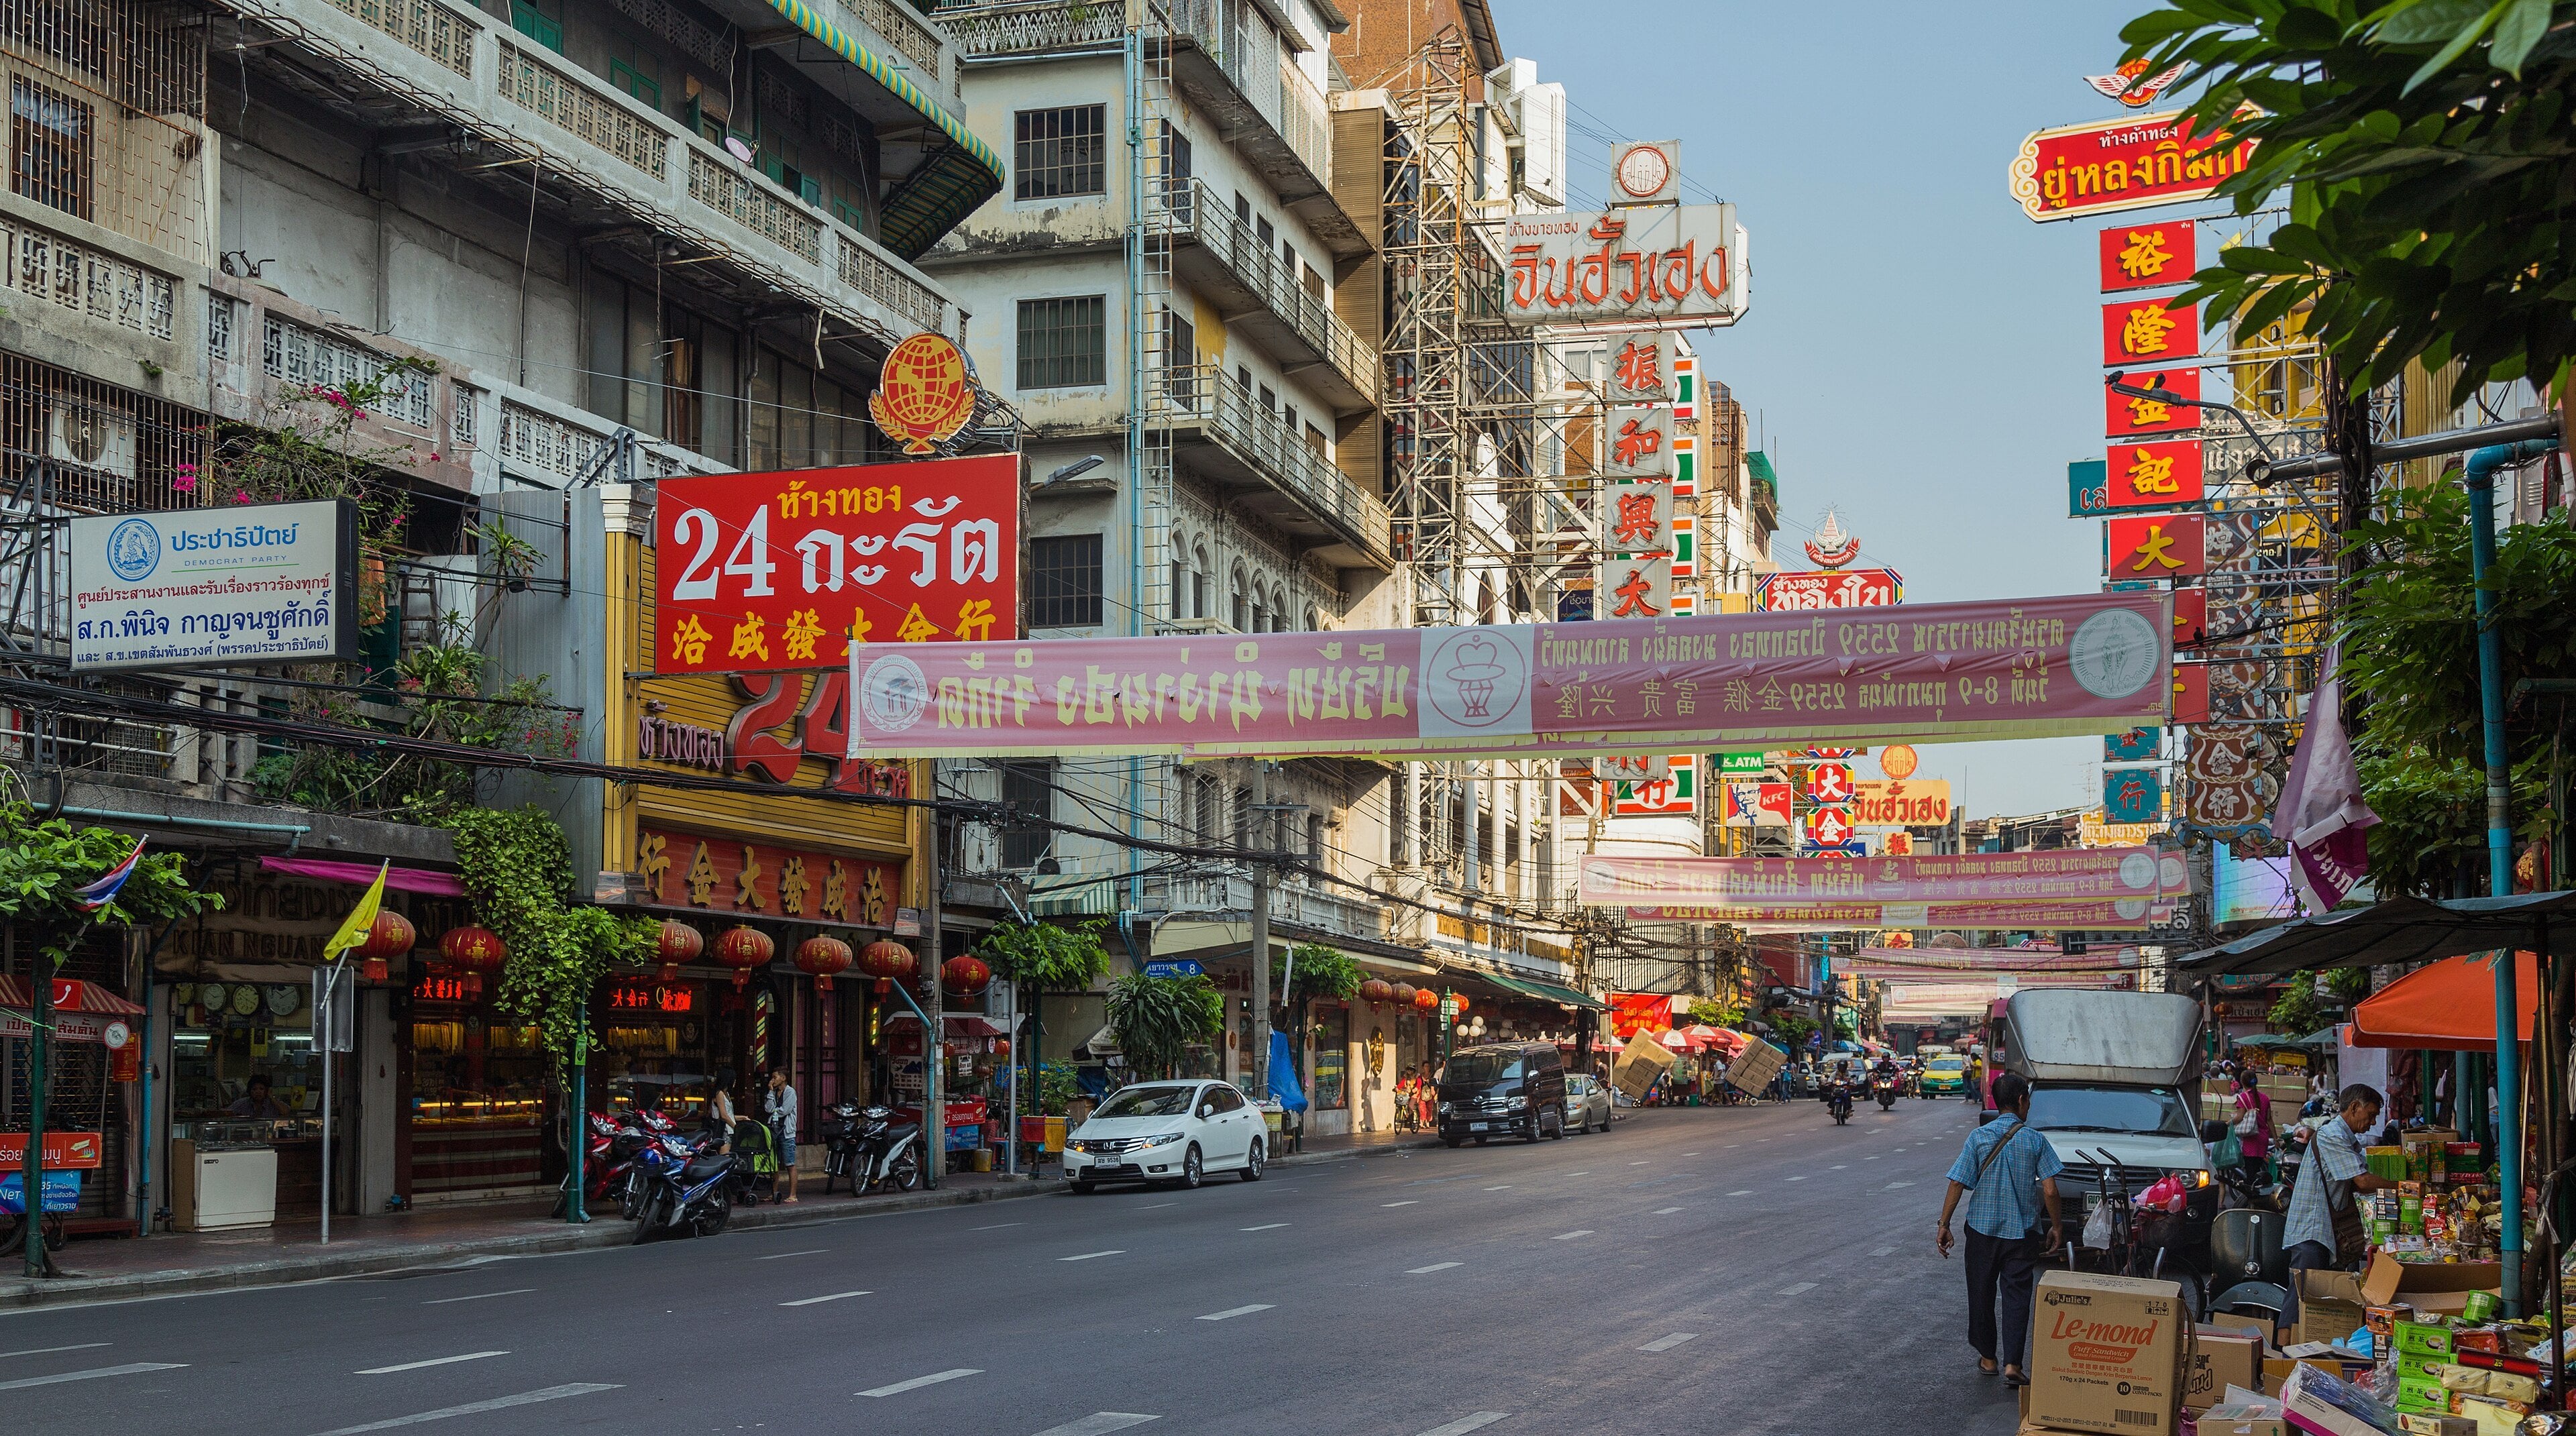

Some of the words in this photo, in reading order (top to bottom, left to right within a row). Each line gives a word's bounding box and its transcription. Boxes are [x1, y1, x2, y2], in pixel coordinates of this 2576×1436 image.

[2099, 127, 2178, 148] ห้างค้าทอง
[1509, 221, 1579, 237] ห้างขายทอง
[1510, 216, 1729, 309] จินฮั้วเฮง
[777, 480, 902, 518] ห้างทอง
[172, 523, 300, 553] ประชาธิปัตย์
[673, 504, 776, 600] 24
[794, 495, 999, 594] กะรัต
[184, 557, 246, 568] DEMOCRAT
[252, 555, 288, 564] PARTY
[1773, 575, 1828, 591] ห้างทอง
[77, 611, 170, 640] ส.ก.พินิจ
[182, 590, 332, 641] กาญจนชูศักดิ์
[77, 651, 101, 663] และ
[217, 634, 329, 657] (พรรคประชาธิปัตย์)
[1735, 757, 1762, 767] ATM
[1762, 791, 1786, 806] KFC
[1189, 963, 1195, 975] 8
[2059, 1294, 2088, 1305] Julie's
[2051, 1311, 2159, 1346] Le-mond
[2073, 1345, 2093, 1354] Puff
[2093, 1347, 2130, 1358] Sandwich
[2059, 1376, 2073, 1384] 170g
